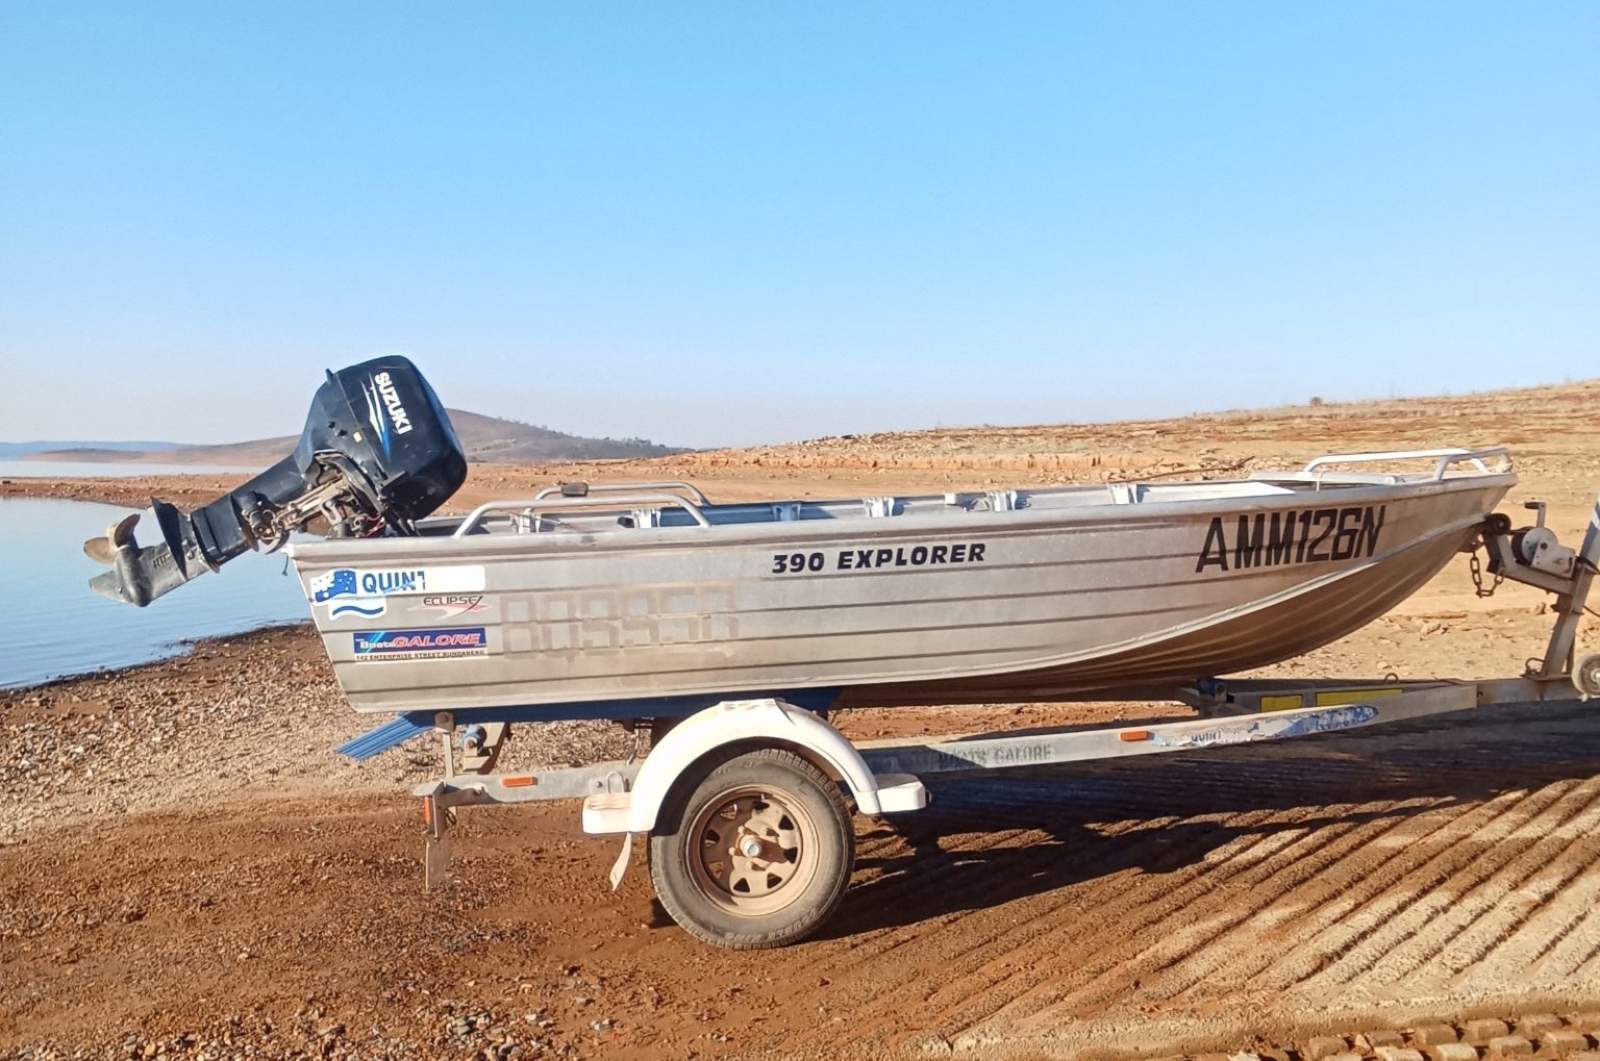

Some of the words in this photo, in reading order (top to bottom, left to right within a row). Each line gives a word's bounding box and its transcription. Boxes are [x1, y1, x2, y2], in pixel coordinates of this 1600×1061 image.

[375, 372, 413, 435] SUZUKI
[1195, 505, 1386, 573] AMM126N
[772, 552, 825, 574] 390
[837, 543, 986, 570] EXPLORER
[423, 596, 481, 606] ECLIPSE
[392, 633, 481, 648] GALORE
